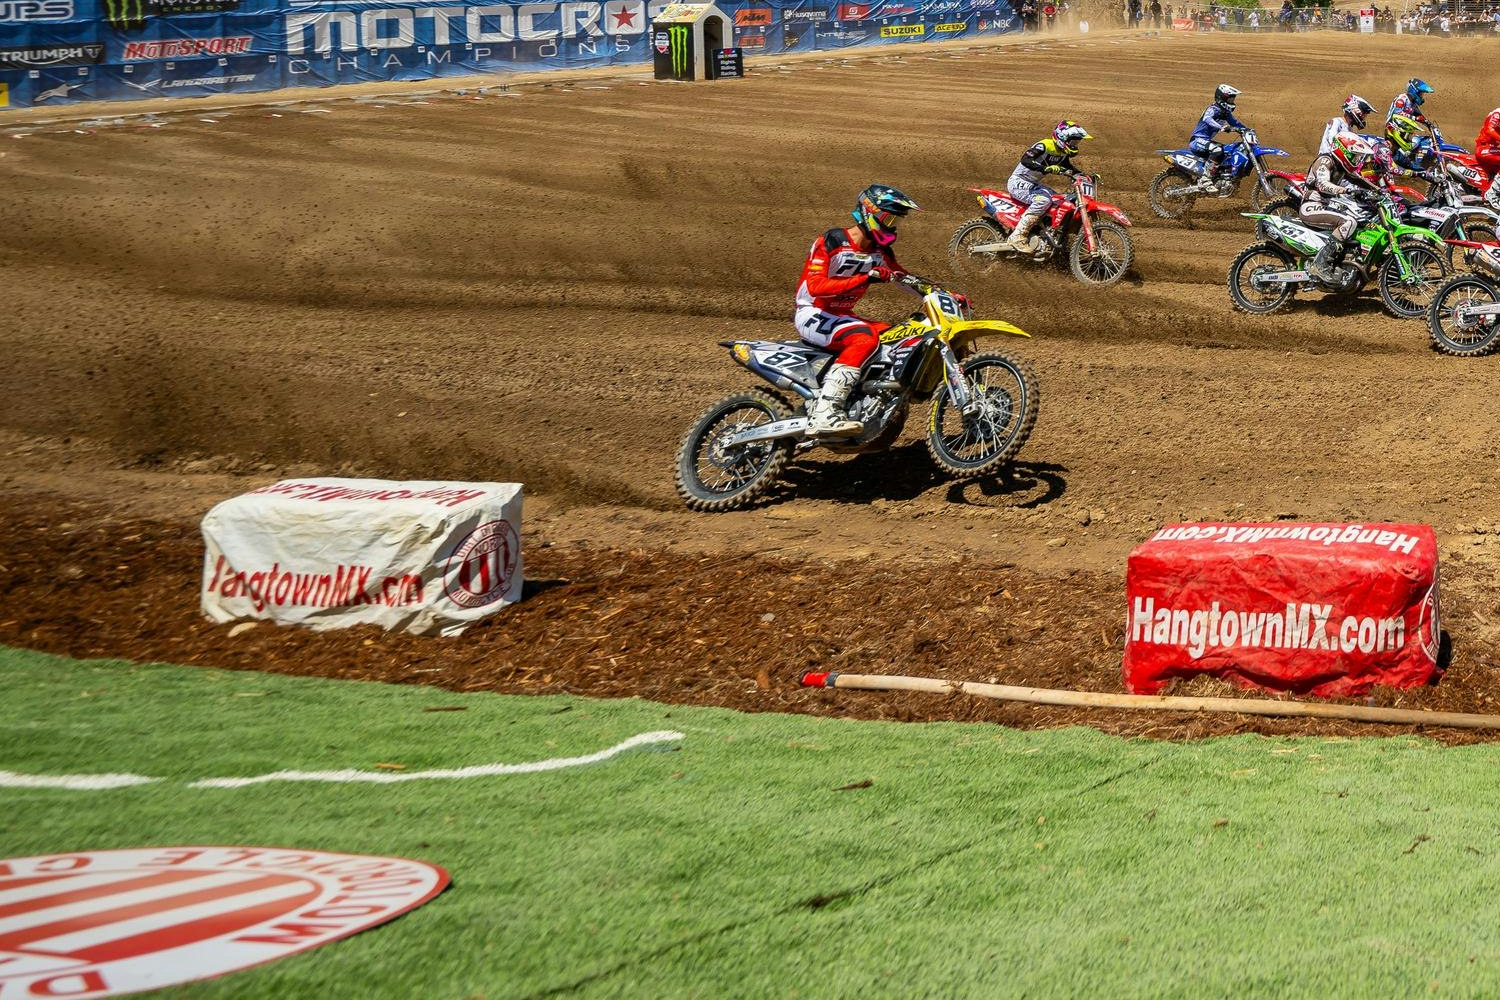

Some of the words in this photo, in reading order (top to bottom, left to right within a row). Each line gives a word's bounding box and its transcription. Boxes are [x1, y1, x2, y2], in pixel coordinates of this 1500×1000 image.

[883, 26, 921, 36] SUZUKI
[0, 47, 84, 62] TRIUMPH
[288, 37, 631, 75] CHAMPIONS
[880, 326, 927, 344] SUZUKI
[1151, 524, 1420, 555] HangtownMX.com
[1131, 596, 1406, 659] HangtownMX.com
